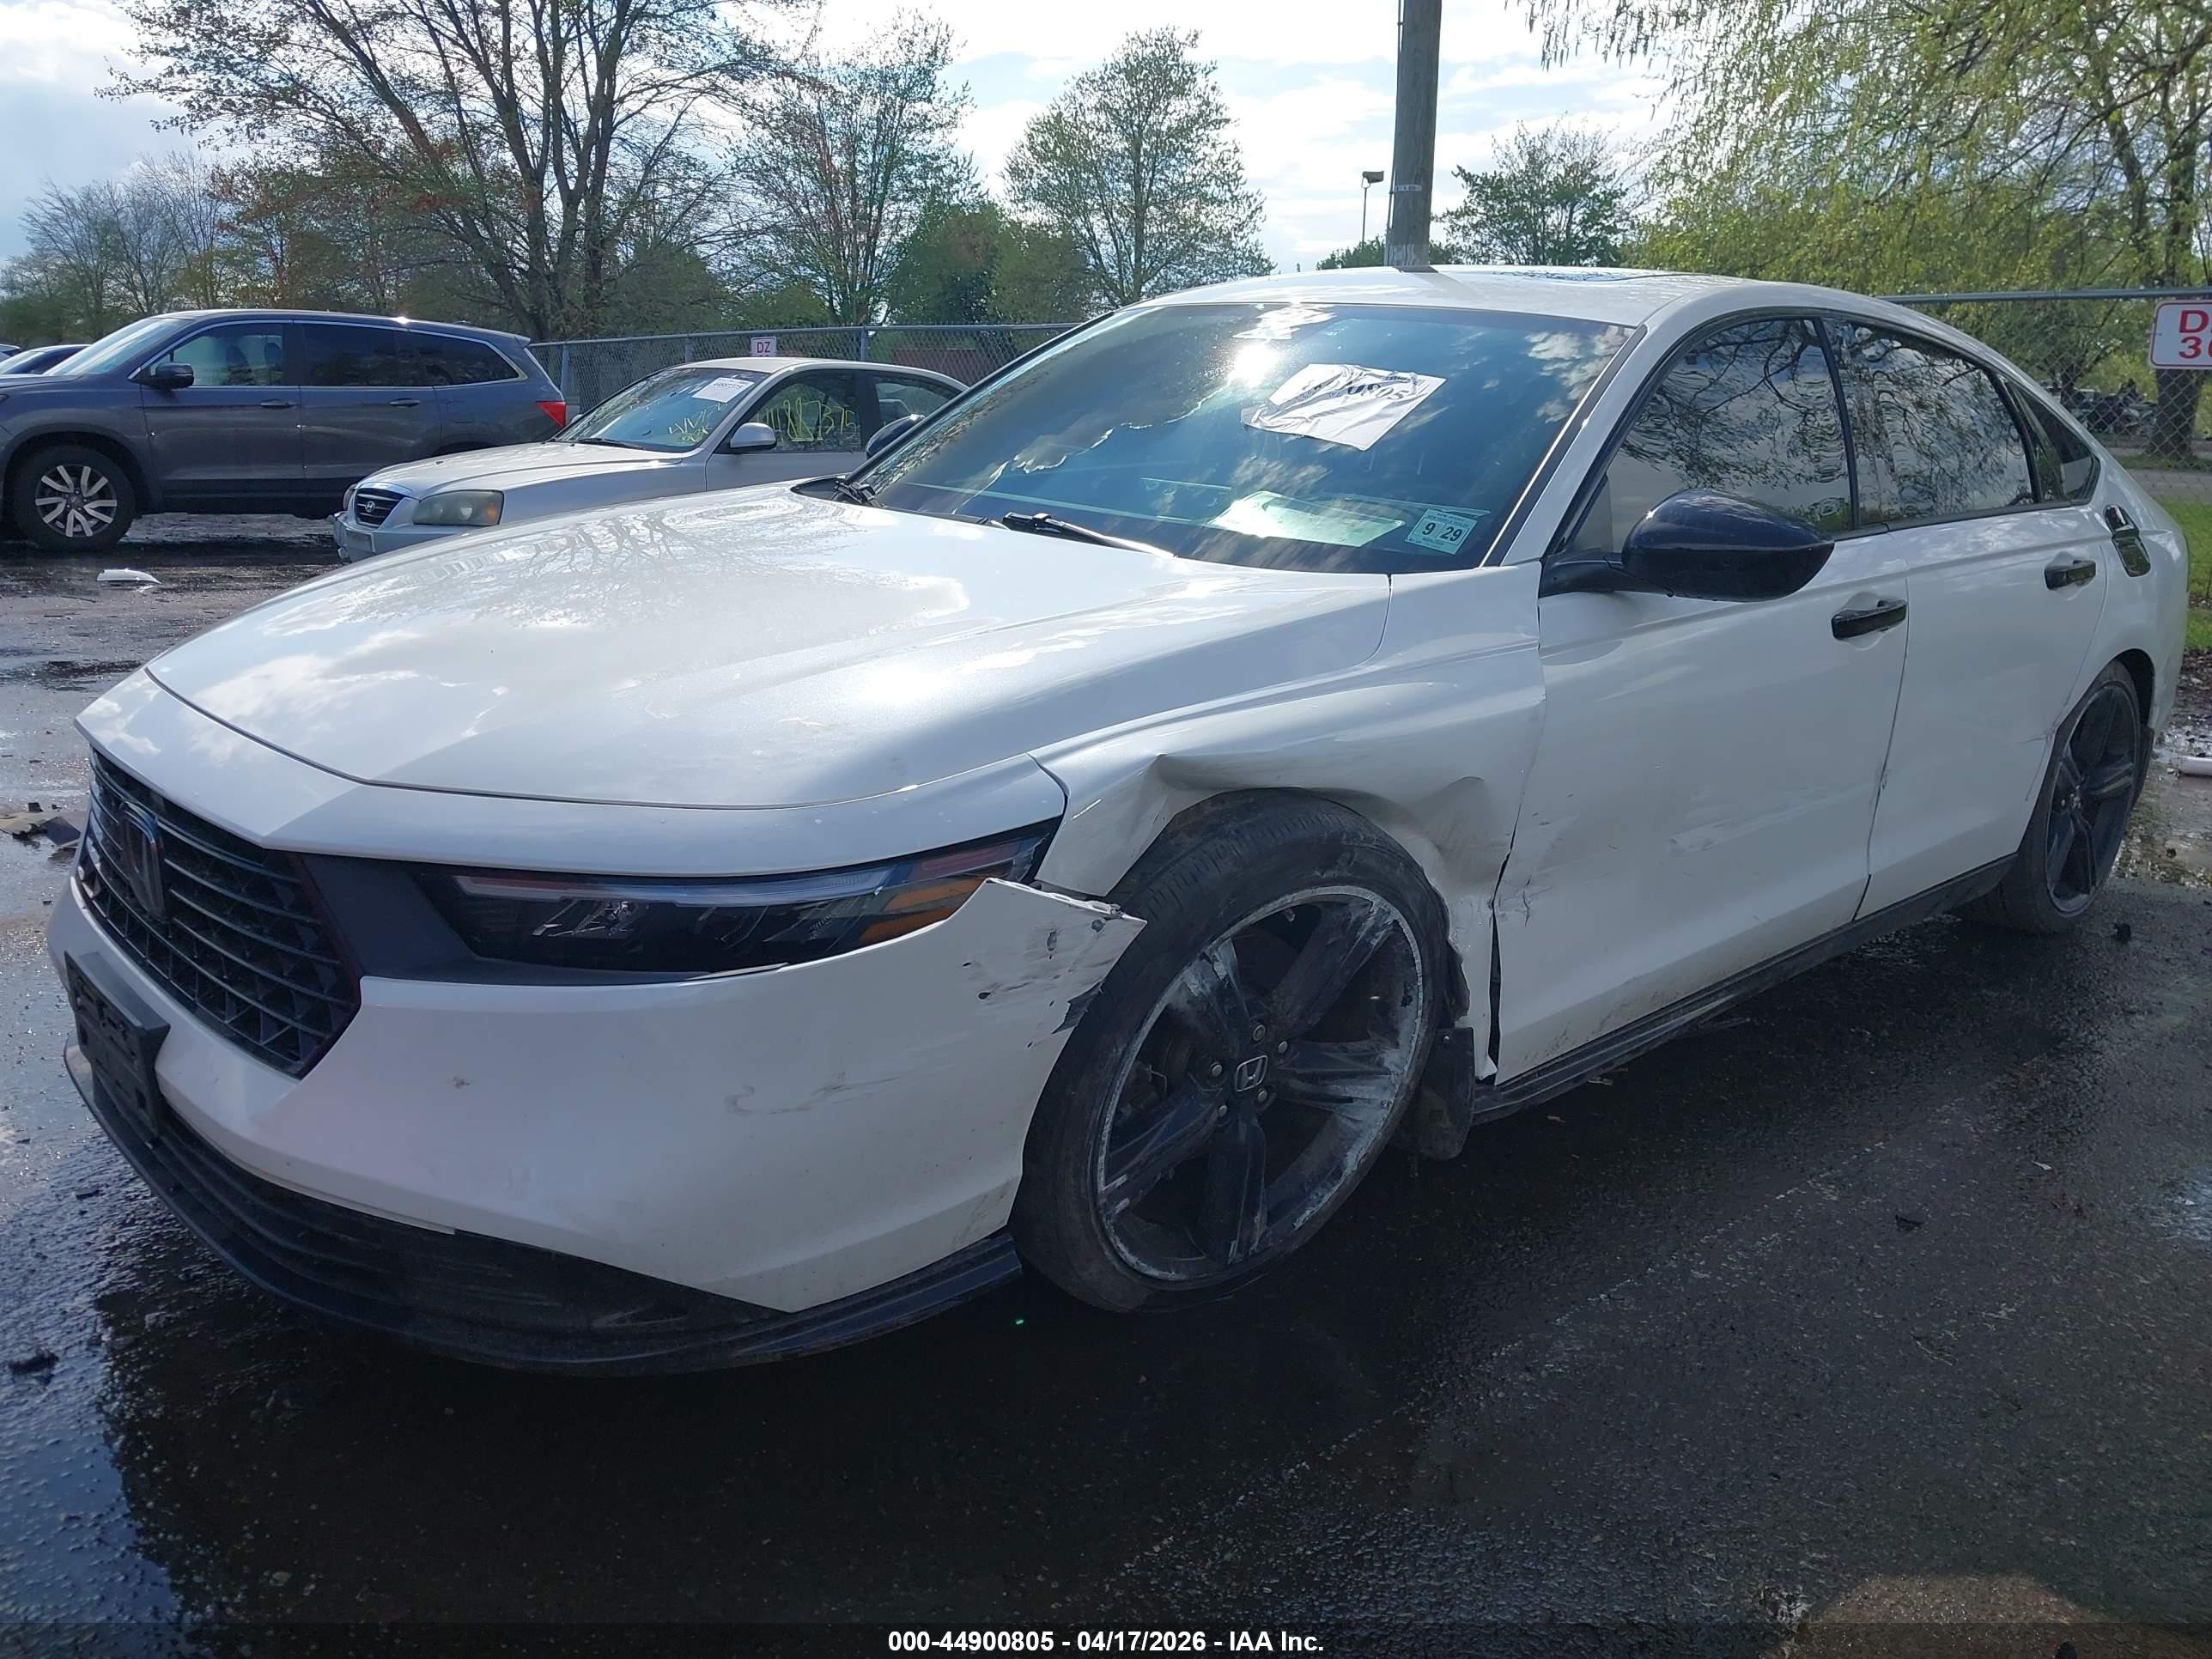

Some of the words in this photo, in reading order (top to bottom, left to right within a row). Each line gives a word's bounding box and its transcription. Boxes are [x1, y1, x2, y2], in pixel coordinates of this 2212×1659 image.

[2179, 309, 2212, 333] D
[757, 341, 771, 353] DZ
[1422, 522, 1437, 536] 9
[1439, 526, 1463, 542] 29
